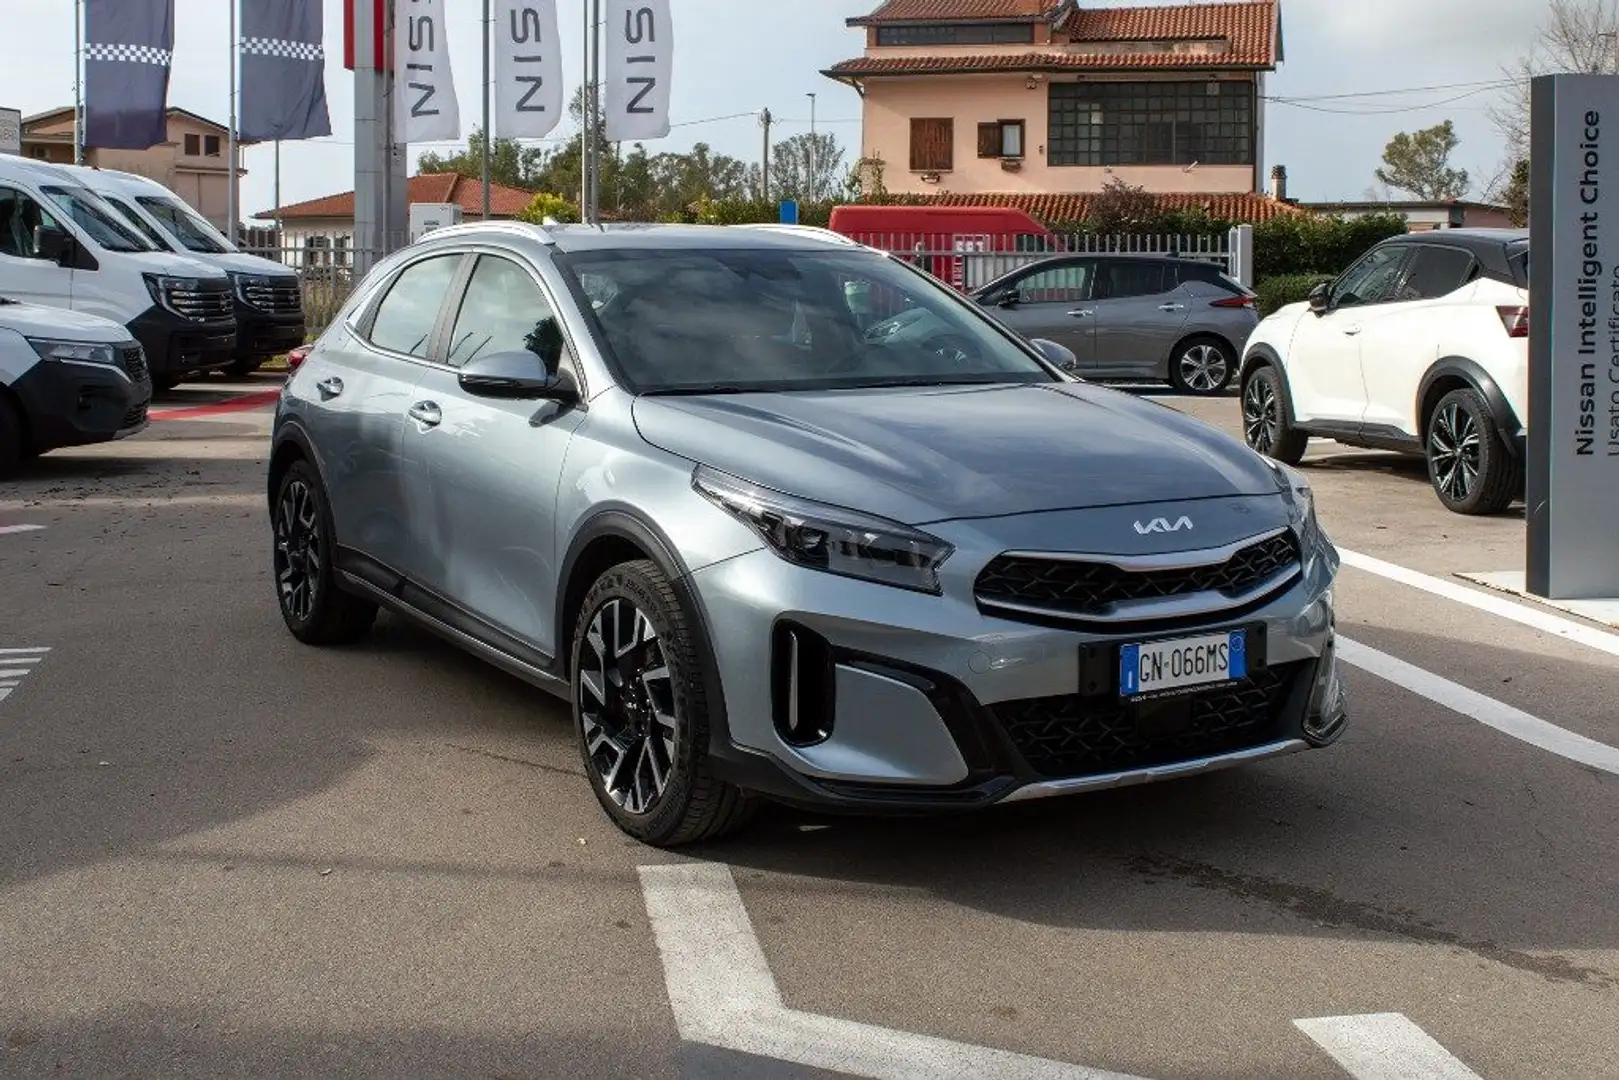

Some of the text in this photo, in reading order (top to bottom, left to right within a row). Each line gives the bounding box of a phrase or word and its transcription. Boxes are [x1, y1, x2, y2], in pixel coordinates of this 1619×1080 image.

[1575, 110, 1602, 456] Nissan Intelligent Choice
